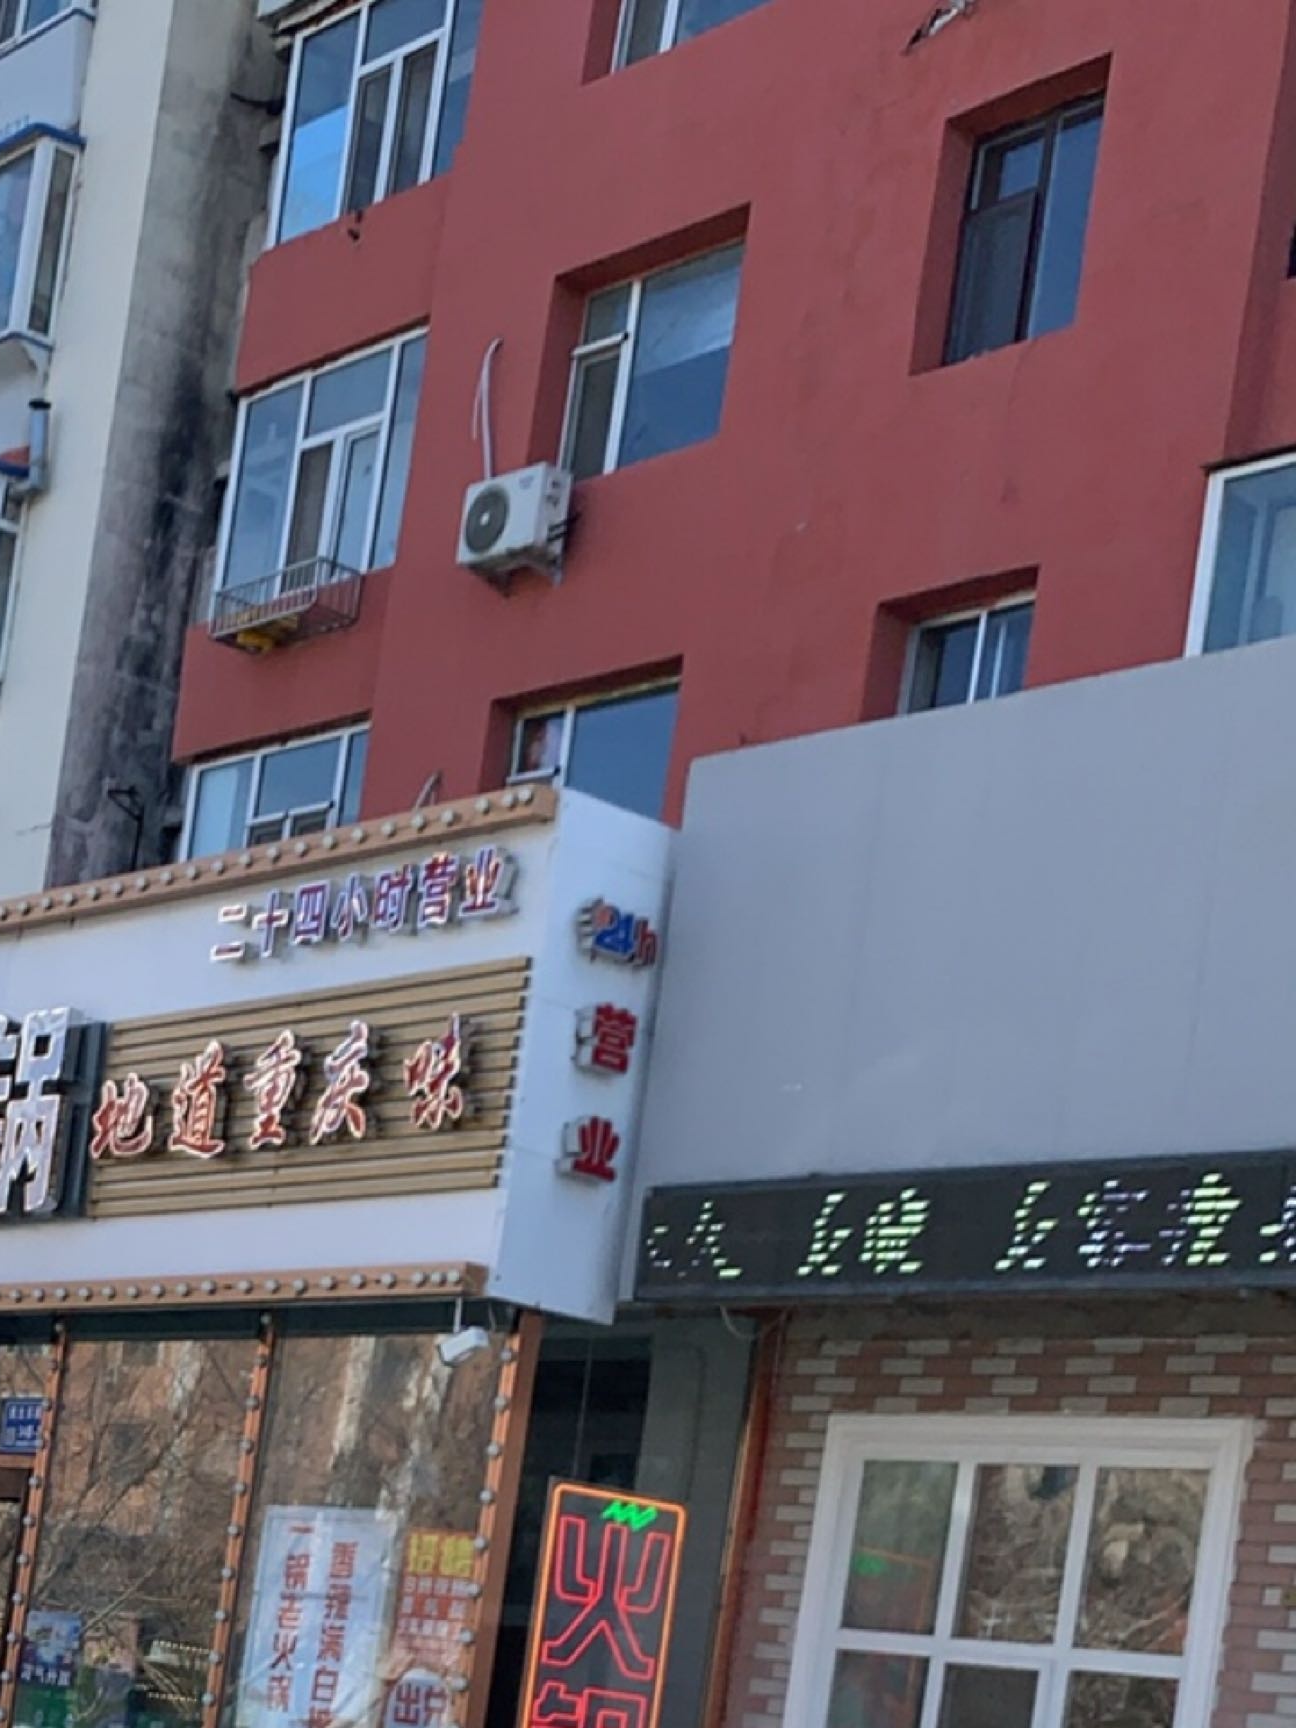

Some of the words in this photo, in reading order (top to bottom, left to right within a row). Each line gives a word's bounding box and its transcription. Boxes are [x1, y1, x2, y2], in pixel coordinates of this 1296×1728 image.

[210, 846, 505, 962] 二十四小时营业
[91, 1013, 466, 1160] 地道重庆味
[570, 1002, 639, 1183] 营业
